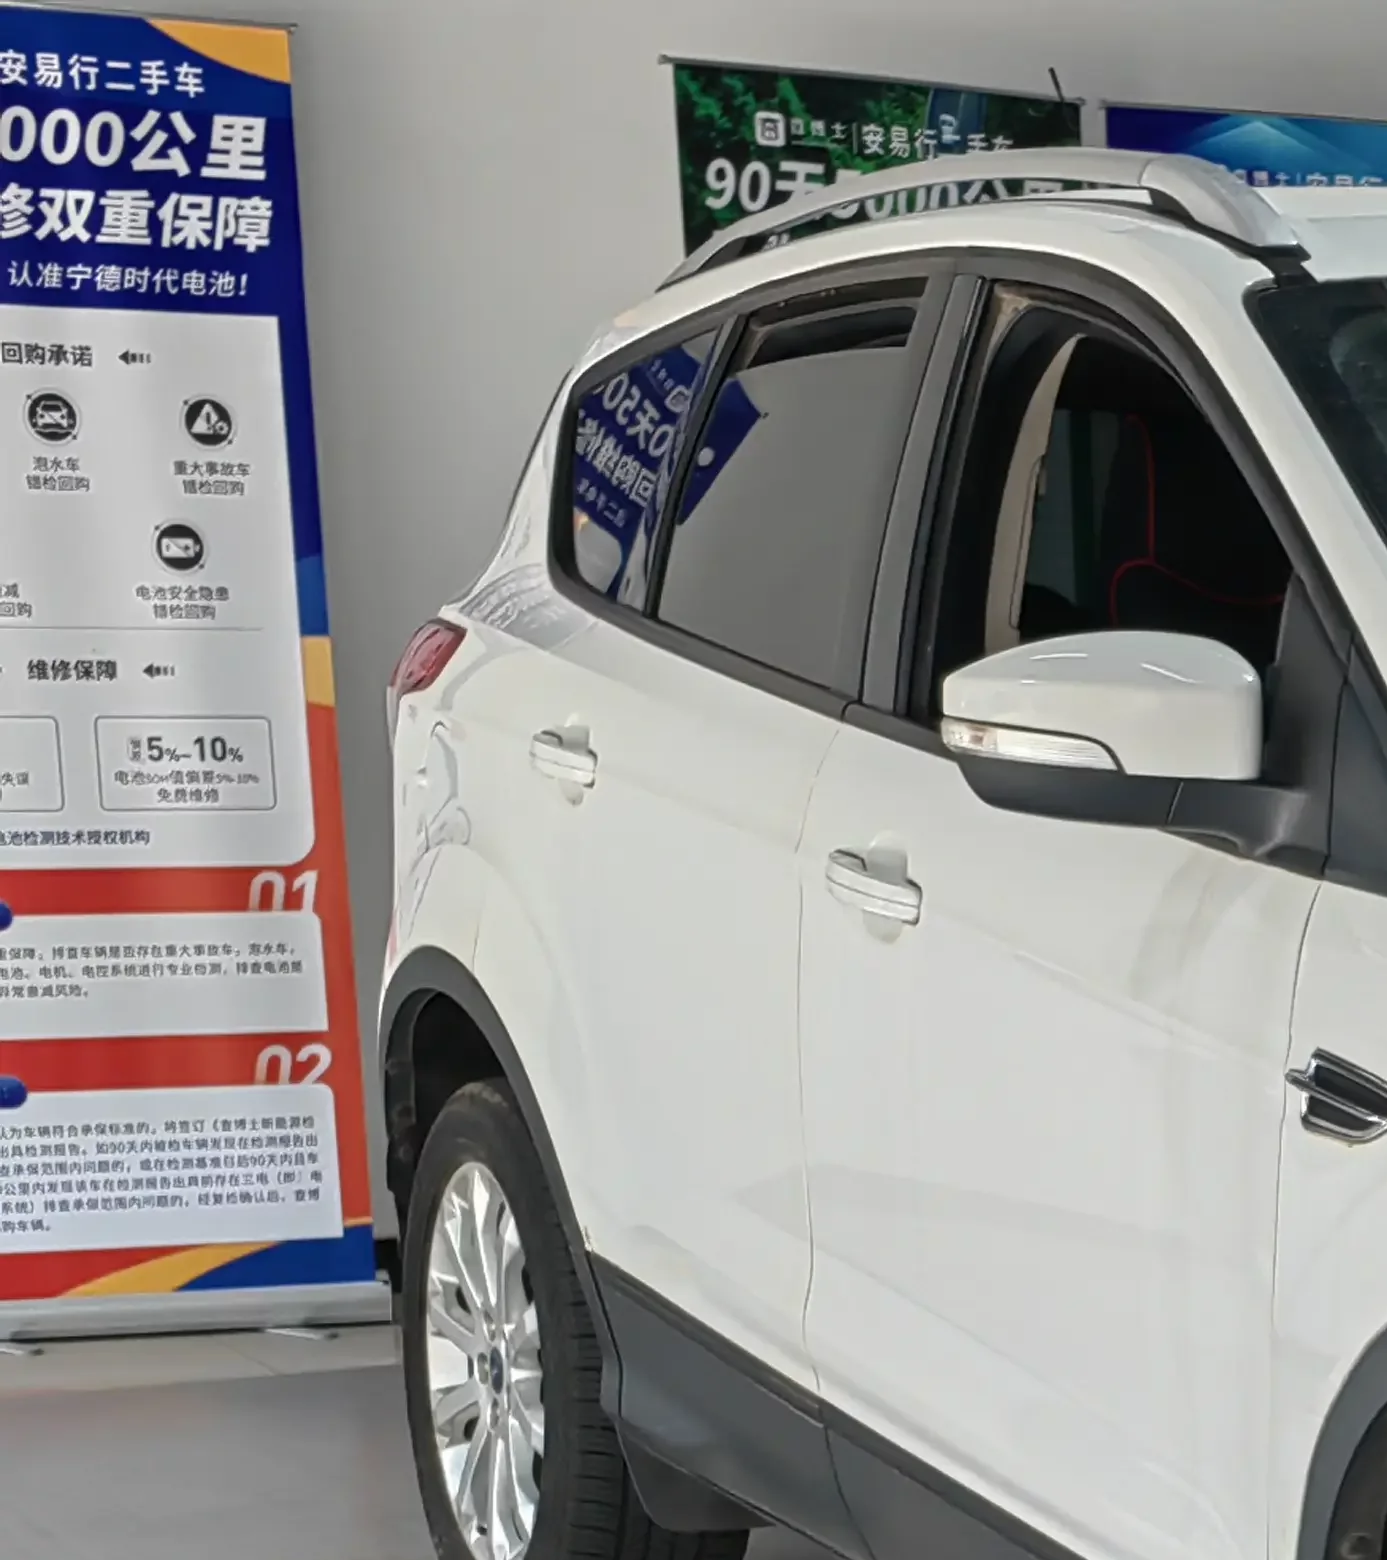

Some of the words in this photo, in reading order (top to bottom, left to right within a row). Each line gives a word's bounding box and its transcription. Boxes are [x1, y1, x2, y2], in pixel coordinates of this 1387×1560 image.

[0, 49, 205, 98] 安易行二手车
[8, 260, 248, 297] 认准宁德时代电池!
[1, 342, 94, 368] 回购承诺
[27, 659, 118, 682] 维修保障
[249, 870, 318, 912] 01
[255, 1043, 332, 1085] 02
